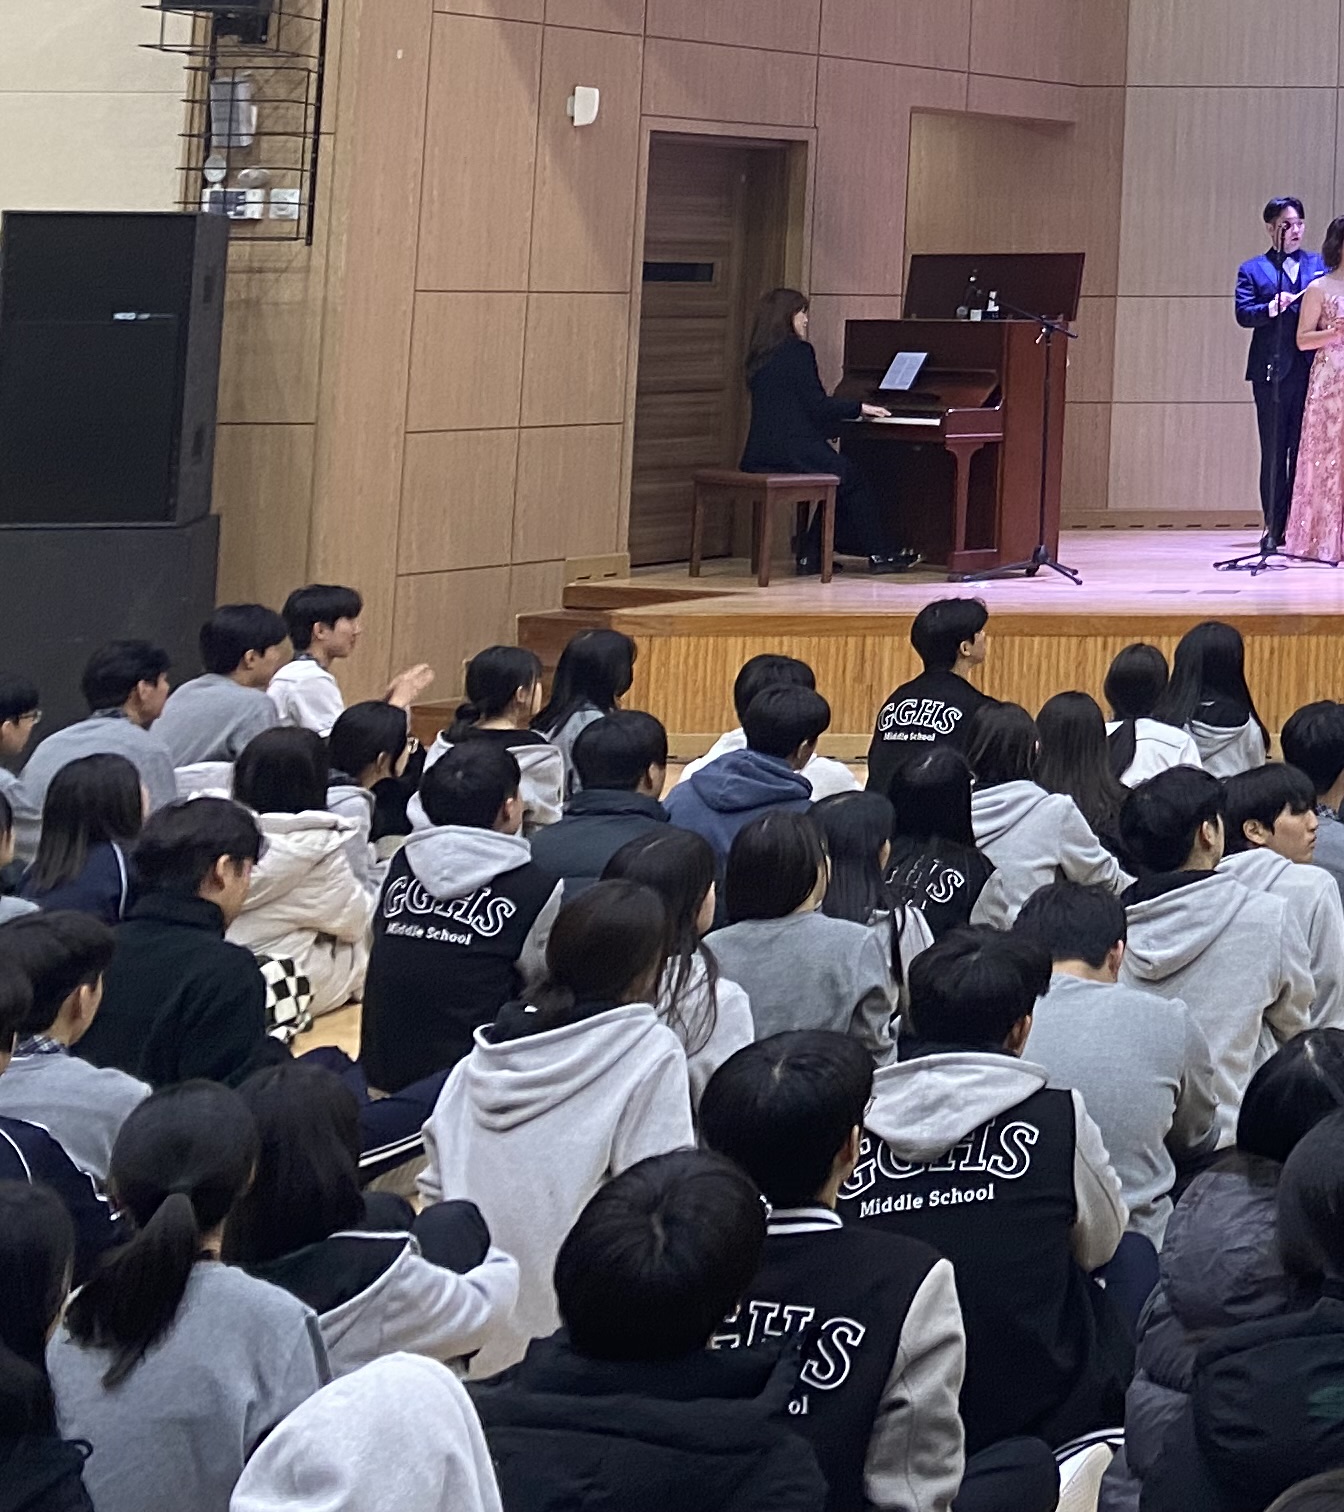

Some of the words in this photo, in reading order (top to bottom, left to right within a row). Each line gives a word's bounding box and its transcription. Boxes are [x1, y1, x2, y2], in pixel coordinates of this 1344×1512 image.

[877, 698, 963, 735] GGHS
[425, 926, 474, 946] School
[859, 1191, 924, 1218] Middle
[928, 1182, 995, 1207] School
